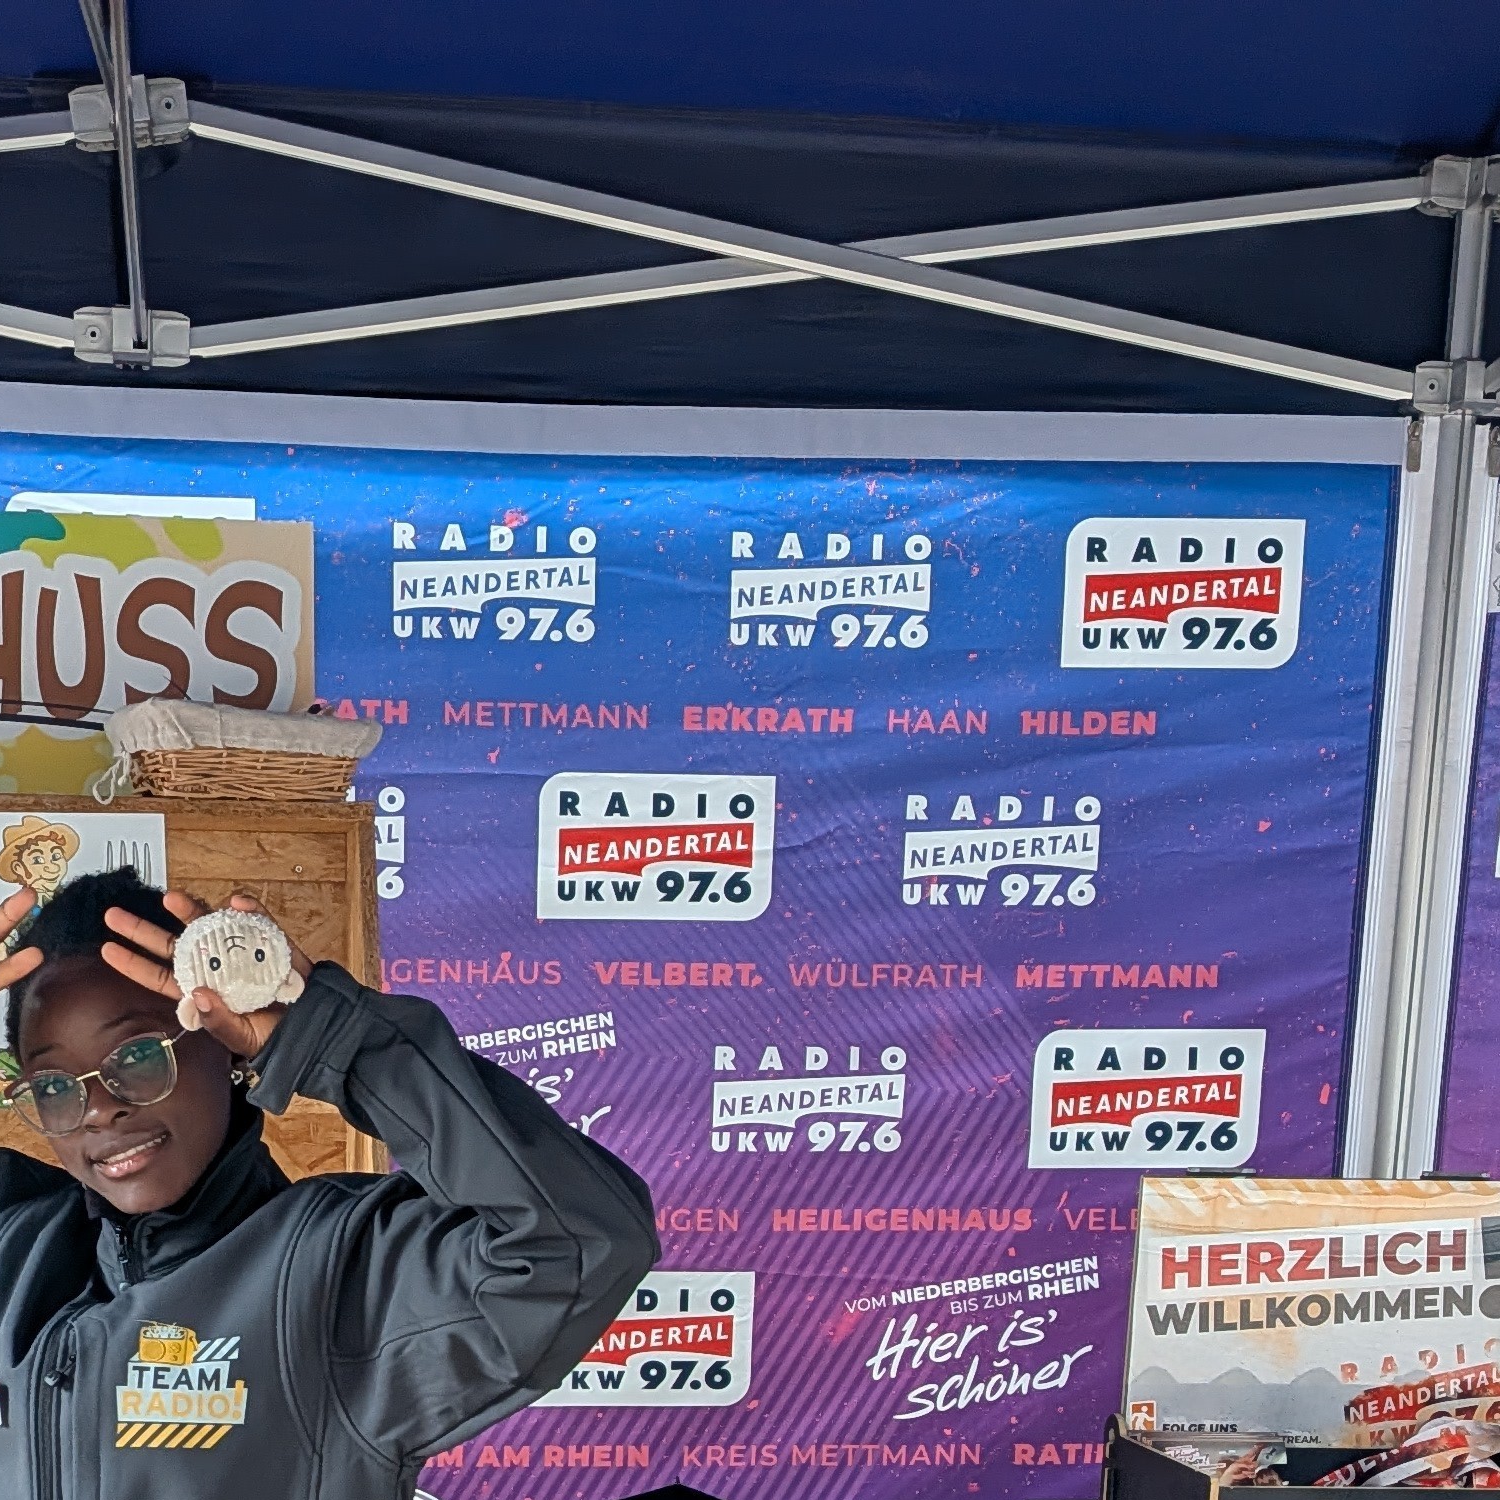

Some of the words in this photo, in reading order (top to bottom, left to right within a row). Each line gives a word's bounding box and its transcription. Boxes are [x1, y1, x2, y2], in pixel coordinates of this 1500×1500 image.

[393, 523, 597, 554] RADIO
[731, 532, 932, 561] RADIO
[1086, 537, 1283, 563] RADIO
[400, 566, 591, 600] NEANDERTAL
[737, 573, 926, 608] NEANDERTAL
[1090, 575, 1276, 612] NEANDERTAL
[393, 616, 480, 639] UKW
[496, 607, 595, 642] 97.6
[730, 624, 815, 647] UKW
[830, 614, 929, 648] 97.6
[1082, 628, 1166, 649] UKW
[1182, 617, 1277, 650] 97.6
[444, 702, 648, 728] METTMANN
[683, 706, 853, 733] ERKRATH
[888, 709, 987, 734] HAAN
[1021, 710, 1156, 735] HILDEN
[559, 791, 755, 818] RADIO
[906, 795, 1100, 822] RADIO
[564, 830, 749, 867] NEANDERTAL
[910, 834, 1094, 868] NEANDERTAL
[558, 880, 641, 901] UKW
[656, 870, 751, 903] 97.6
[902, 884, 986, 905] UKW
[1000, 874, 1096, 907] 97.6
[790, 956, 982, 988] WÜLFRATH
[1016, 964, 1219, 988] METTMANN
[497, 1047, 538, 1067] ZUM
[542, 1029, 617, 1059] RHEIN
[714, 1046, 907, 1072] RADIO
[1053, 1046, 1245, 1072] RADIO
[718, 1080, 900, 1118] NEANDERTAL
[1055, 1080, 1237, 1118] NEANDERTAL
[711, 1131, 792, 1152] UKW
[808, 1121, 901, 1153] 97.6
[1049, 1130, 1131, 1152] UKW
[1145, 1121, 1238, 1153] 97.6
[773, 1208, 1032, 1233] HEILIGENHAUS
[1161, 1229, 1467, 1290] HERZLICH
[845, 1295, 887, 1313] VOM
[891, 1255, 1098, 1305] NIEDERBERGISCHEN
[950, 1301, 978, 1315] BIS
[983, 1290, 1022, 1309] ZUM
[1028, 1273, 1100, 1300] RHEIN
[866, 1313, 988, 1380] Hier
[132, 1365, 221, 1391] TEAM
[640, 1360, 732, 1390] 97.6
[893, 1345, 1093, 1420] schöner
[121, 1380, 245, 1420] RADIO!
[1350, 1367, 1500, 1424] NEANDERTAL
[1210, 1424, 1238, 1433] UNS
[476, 1446, 530, 1467] AM
[544, 1445, 649, 1468] RHEIN
[683, 1444, 777, 1468] KREIS
[792, 1444, 981, 1467] METTMANN
